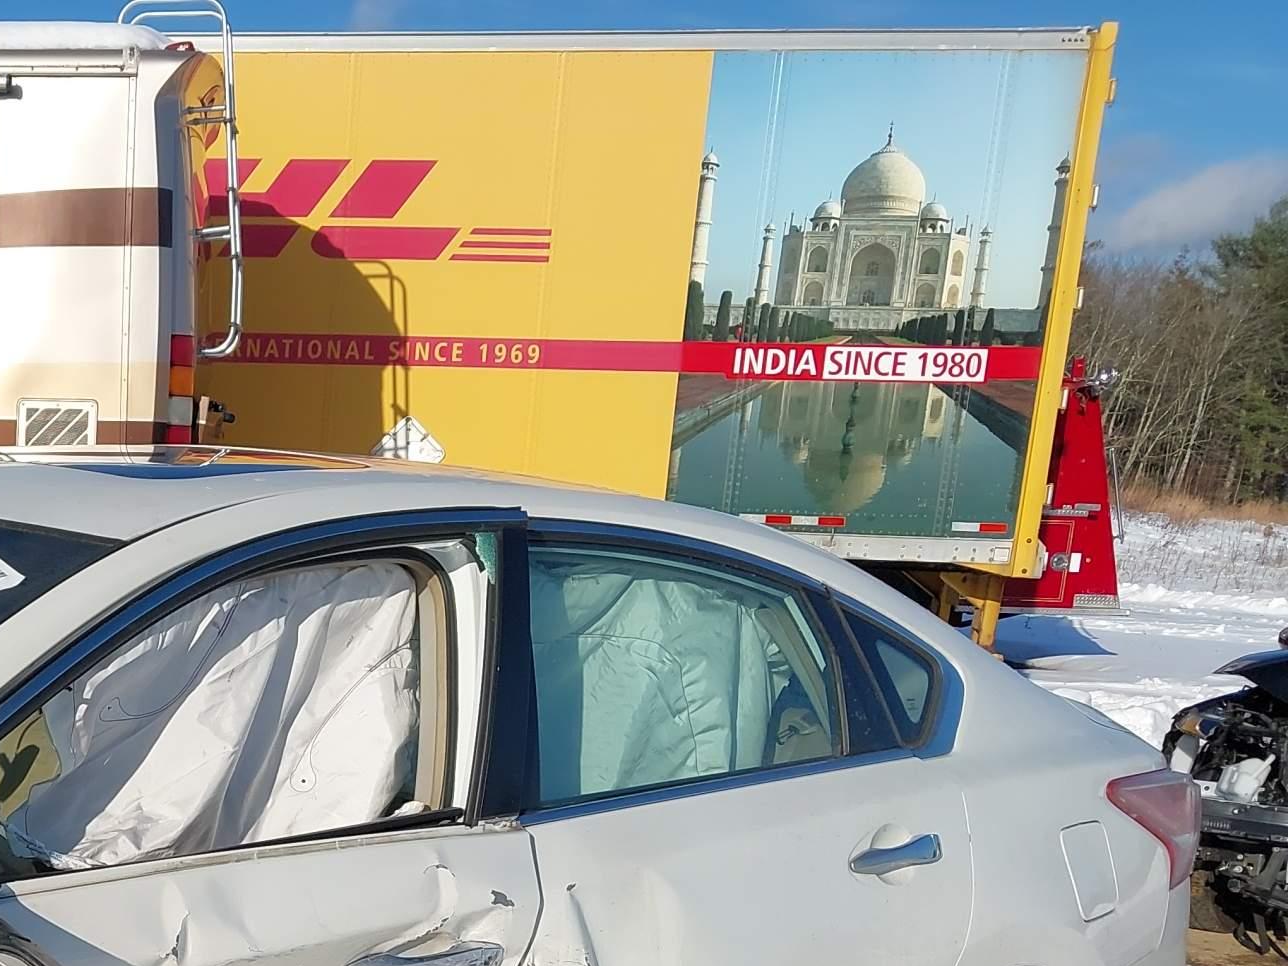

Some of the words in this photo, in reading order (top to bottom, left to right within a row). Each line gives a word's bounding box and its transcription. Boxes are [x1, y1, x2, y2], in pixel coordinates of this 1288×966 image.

[203, 159, 461, 260] HL
[388, 340, 464, 362] SINCE
[479, 343, 542, 364] 1969
[732, 347, 817, 376] INDIA
[827, 349, 908, 377] SINCE
[918, 351, 983, 378] 1980
